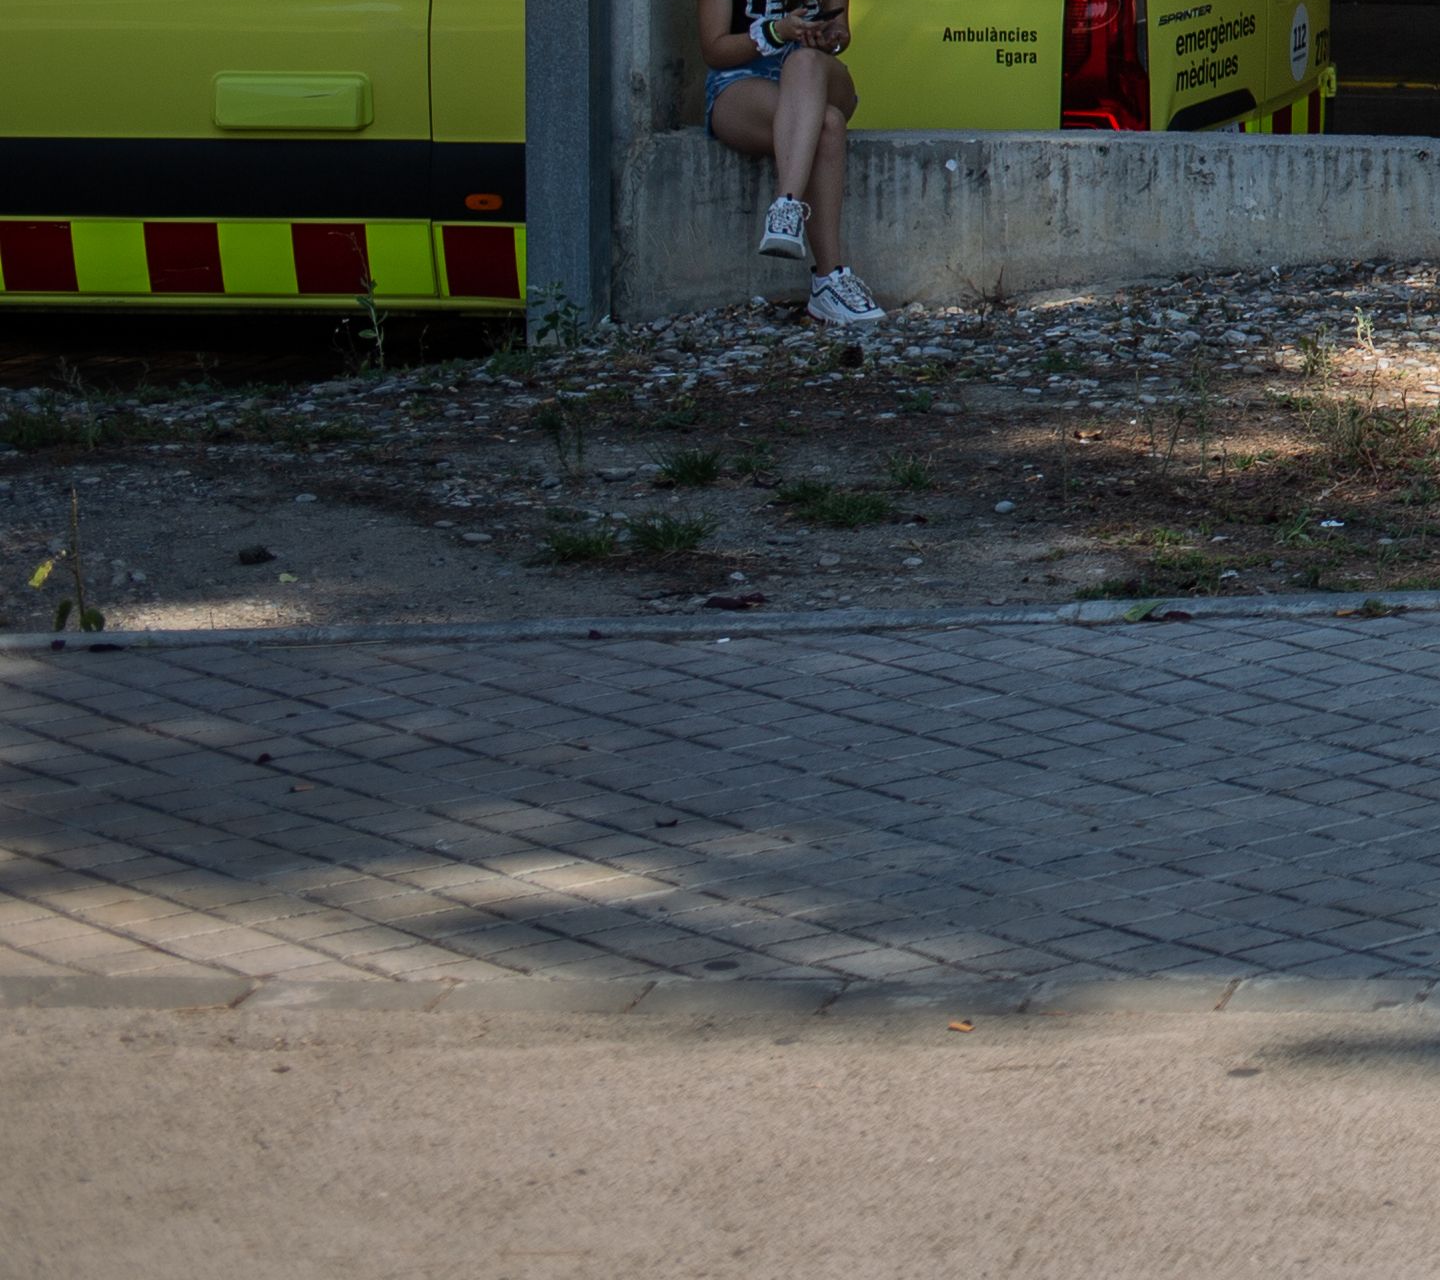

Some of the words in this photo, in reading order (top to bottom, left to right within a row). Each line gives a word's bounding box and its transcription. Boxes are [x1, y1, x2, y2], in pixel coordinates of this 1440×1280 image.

[1158, 4, 1213, 27] SPRINTER
[942, 26, 1038, 43] Ambulàncies
[1175, 11, 1256, 57] emergències
[1293, 23, 1307, 53] 112
[995, 48, 1038, 67] Egara
[1175, 53, 1239, 92] mèdiques
